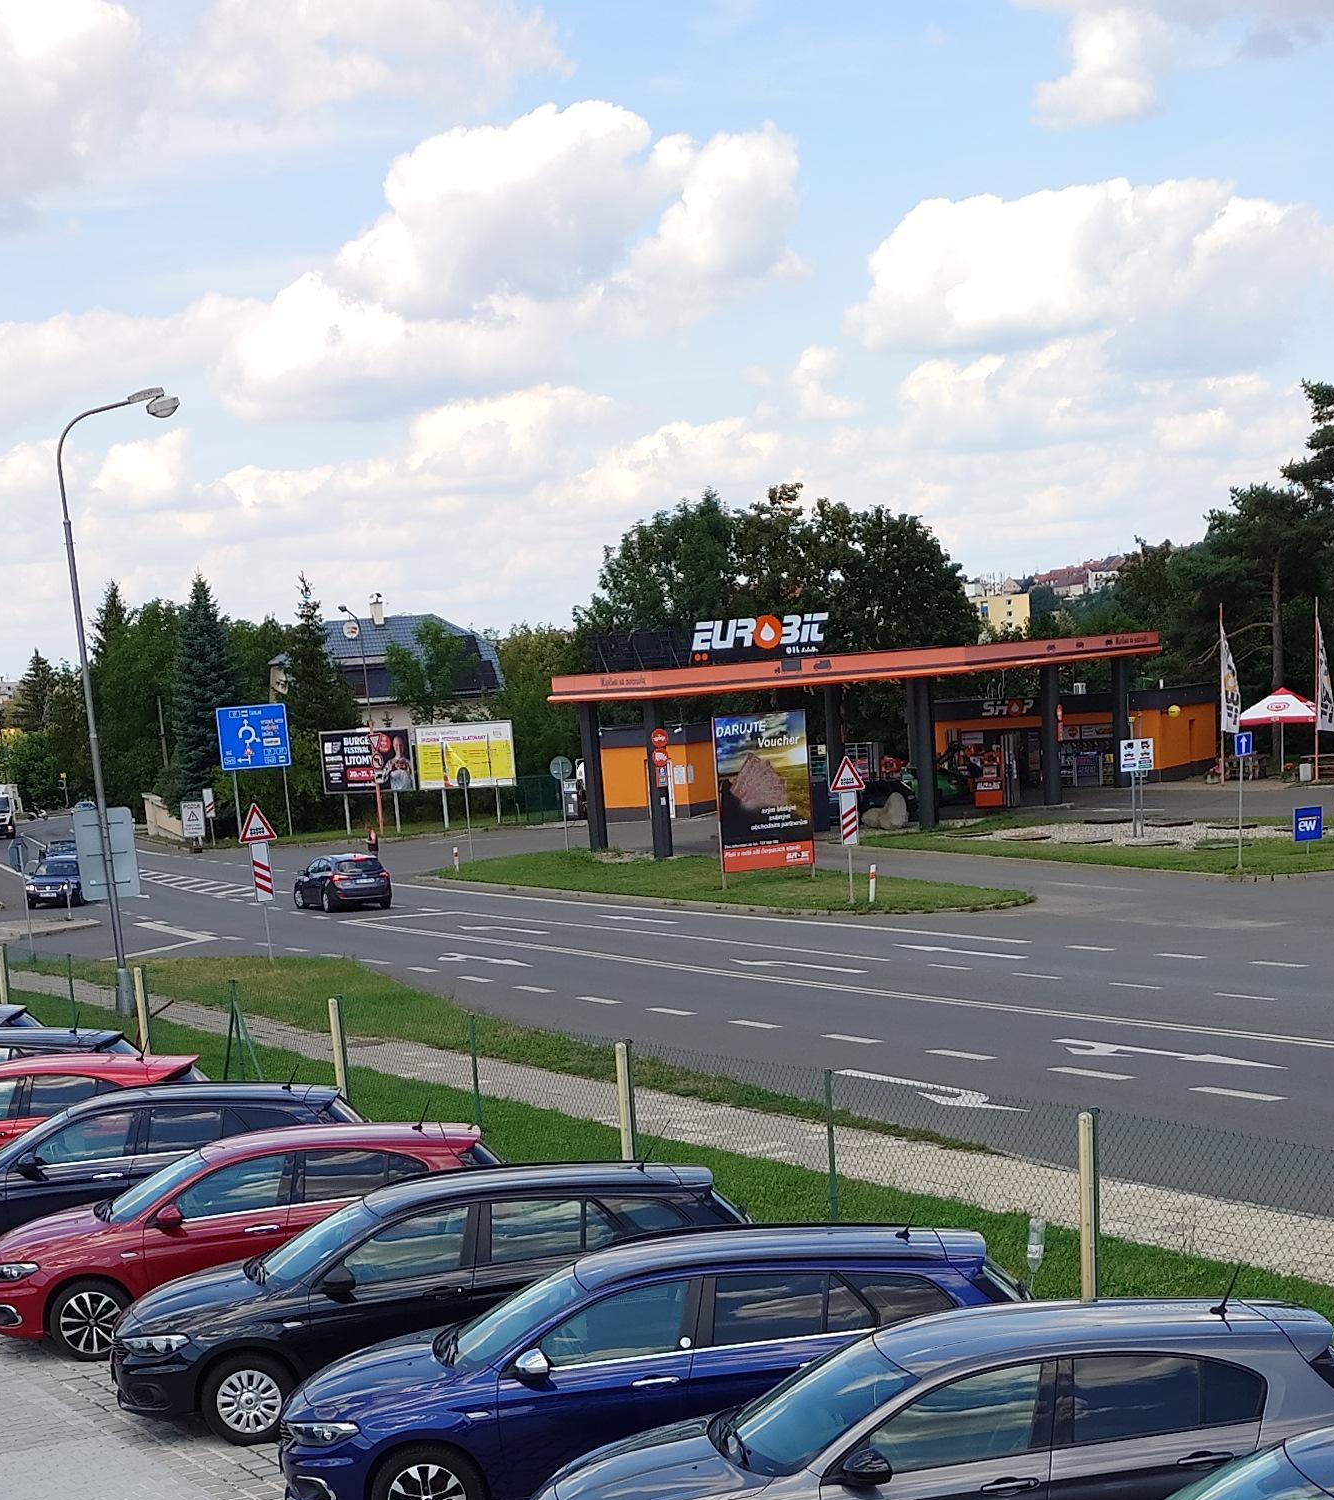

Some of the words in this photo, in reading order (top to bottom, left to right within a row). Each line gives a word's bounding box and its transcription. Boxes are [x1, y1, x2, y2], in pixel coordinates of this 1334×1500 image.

[691, 612, 829, 650] EUROBIT
[982, 699, 1034, 716] SHOP
[716, 720, 766, 737] DARUJTE
[343, 736, 370, 746] BURGE
[757, 734, 800, 748] Voucher
